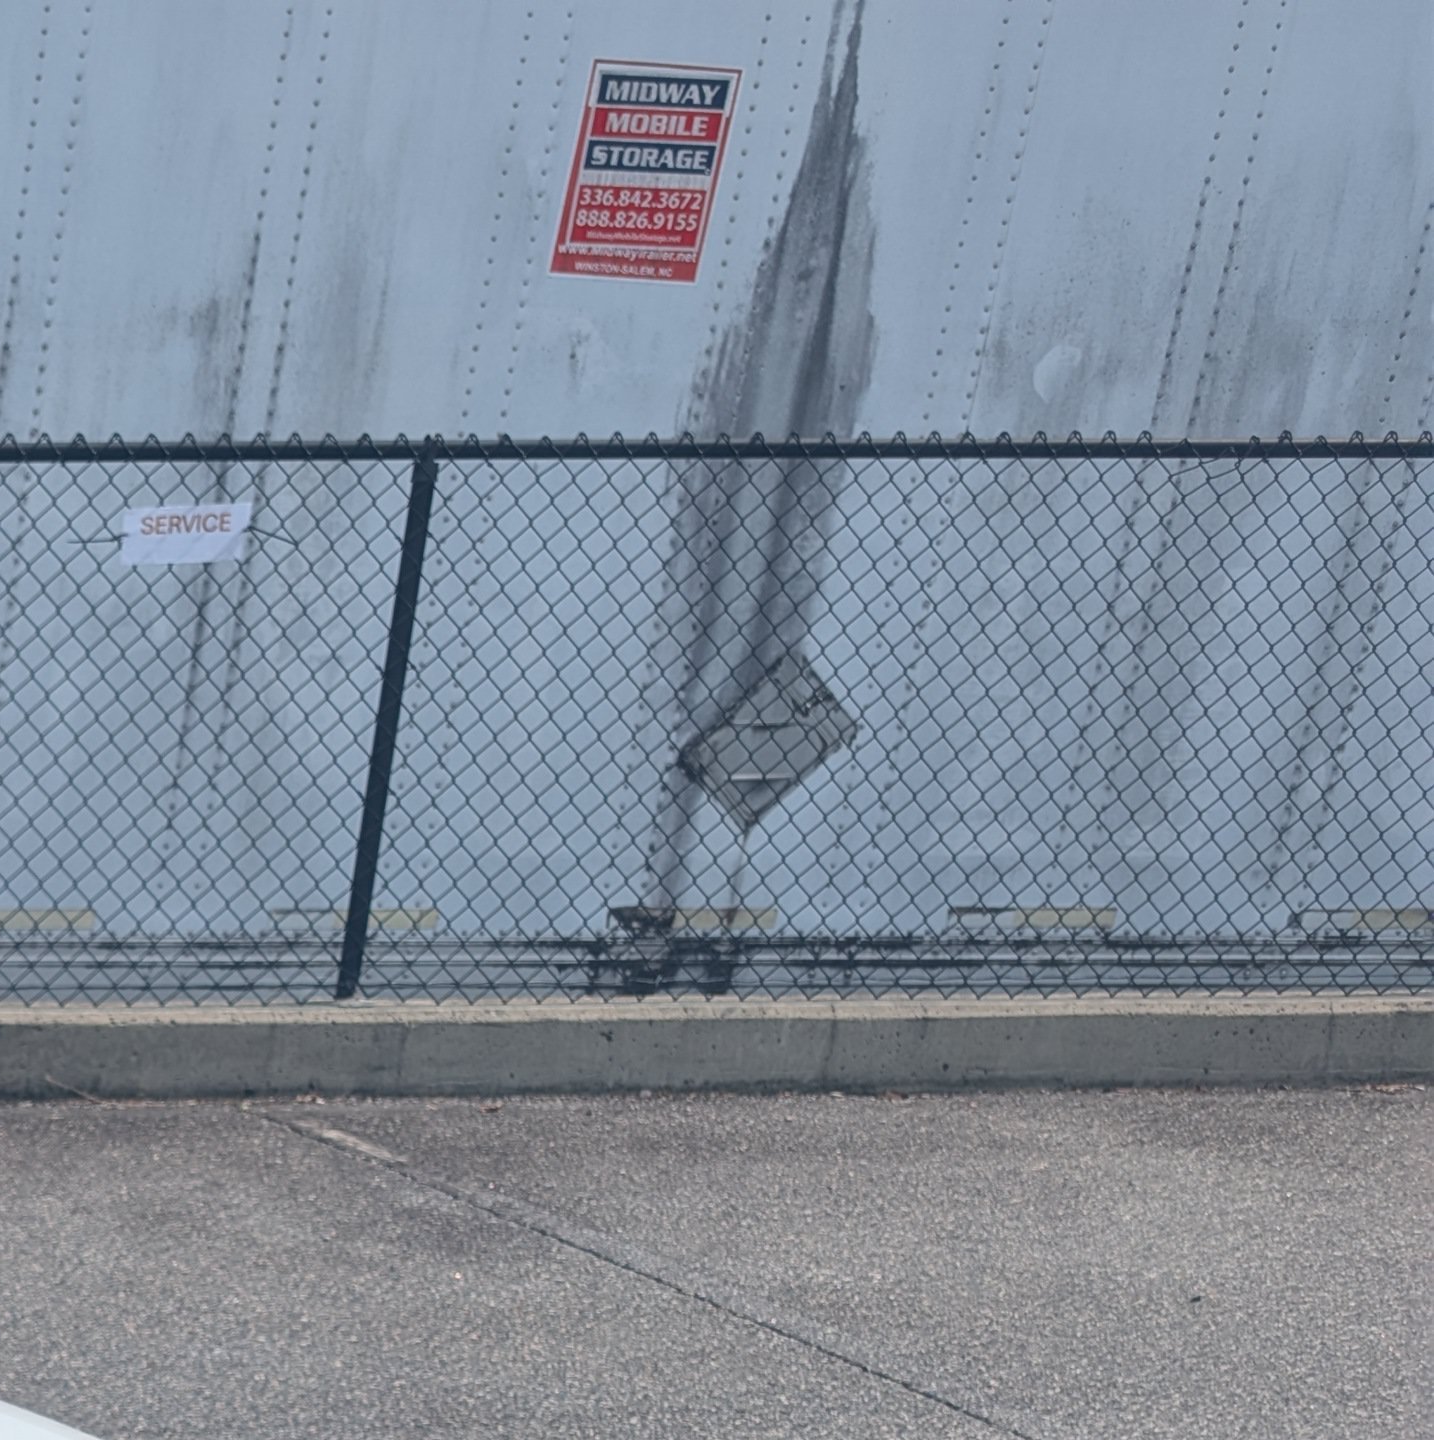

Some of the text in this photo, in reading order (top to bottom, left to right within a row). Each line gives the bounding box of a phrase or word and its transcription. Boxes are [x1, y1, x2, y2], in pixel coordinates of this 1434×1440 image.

[605, 80, 720, 105] MIDWAY
[605, 112, 709, 136] MOBILE
[591, 146, 709, 170] STORAGE
[580, 188, 703, 210] 336.842.3672
[576, 210, 698, 232] 888.826.9155
[140, 512, 231, 535] SERVICE
